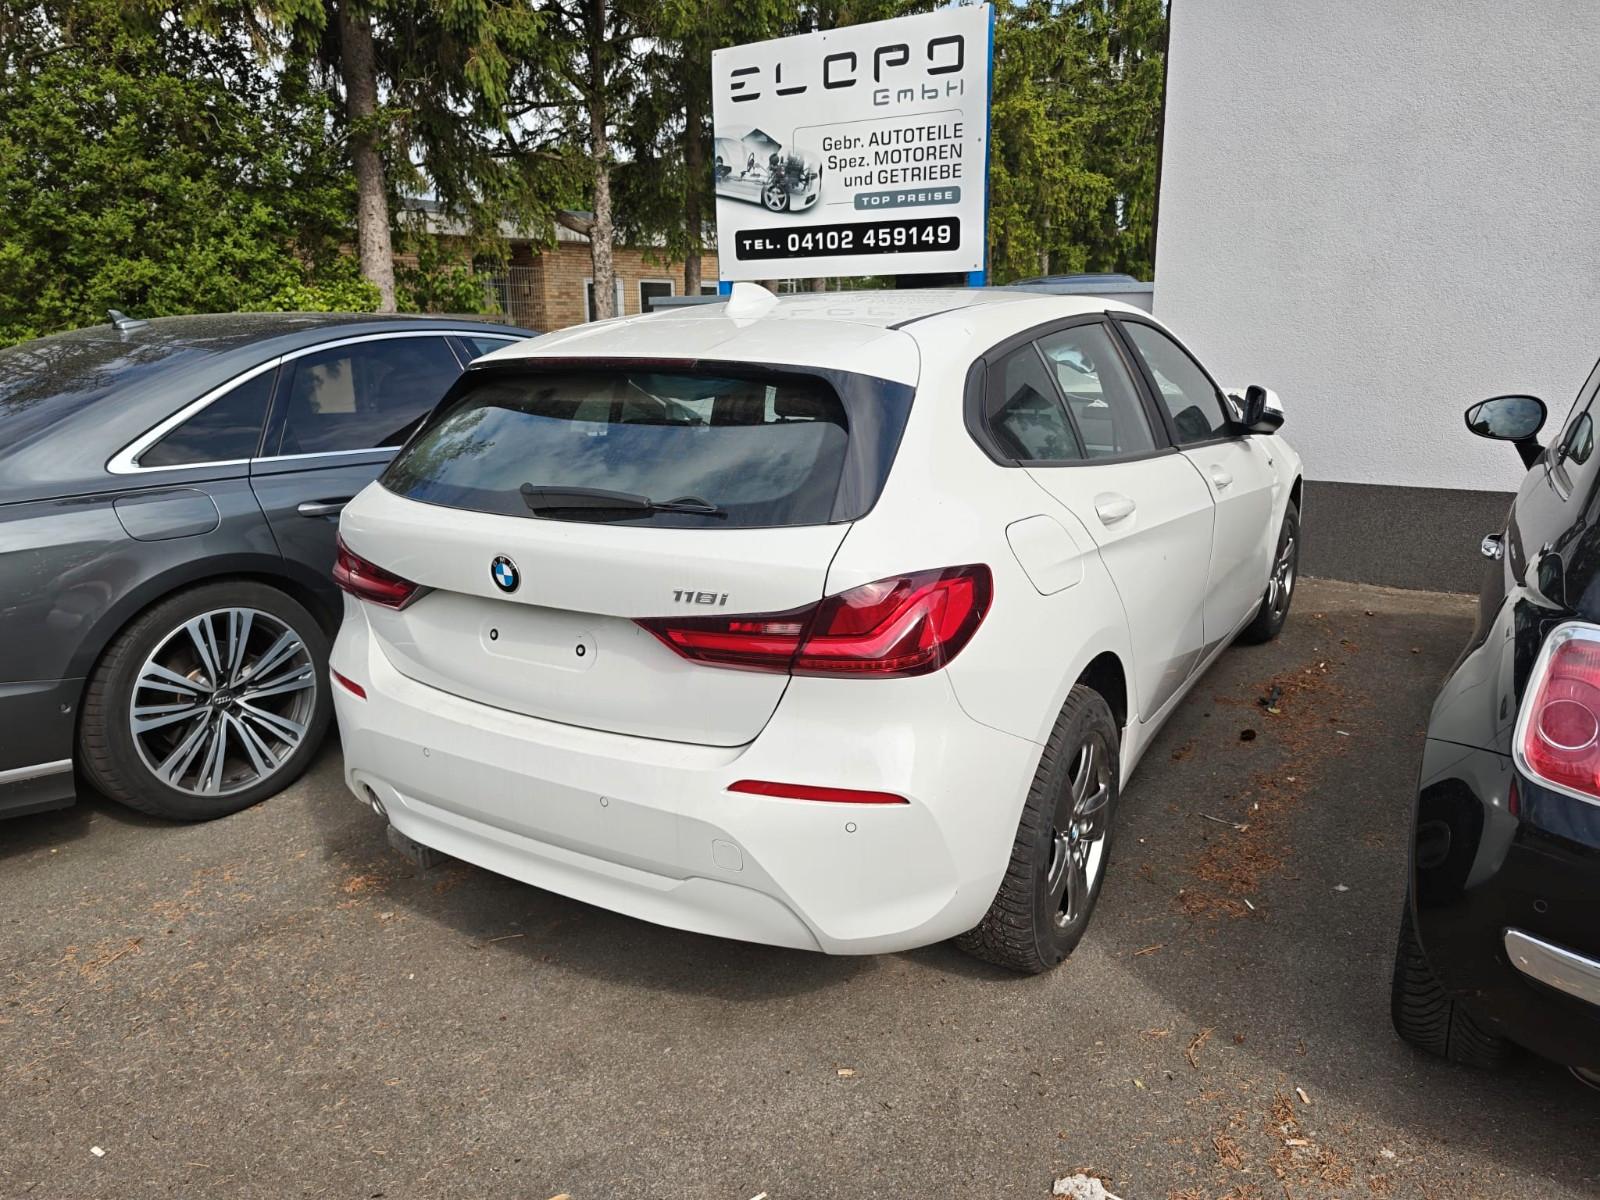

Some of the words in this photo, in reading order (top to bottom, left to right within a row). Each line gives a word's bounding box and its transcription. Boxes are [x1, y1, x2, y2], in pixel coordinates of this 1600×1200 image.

[730, 34, 965, 103] ELOPO
[873, 79, 964, 106] GmbH
[822, 135, 864, 152] Gebr.
[868, 122, 964, 147] AUTOTEILE
[827, 155, 870, 172] Spez.
[874, 143, 962, 166] MOTOREN
[844, 171, 873, 187] und
[877, 163, 962, 185] GETRIEBE
[862, 195, 891, 206] TOP
[897, 191, 953, 203] PREISE
[743, 239, 781, 251] TEL.
[787, 230, 854, 252] 04102
[862, 225, 951, 247] 459149
[672, 590, 729, 606] 118i
